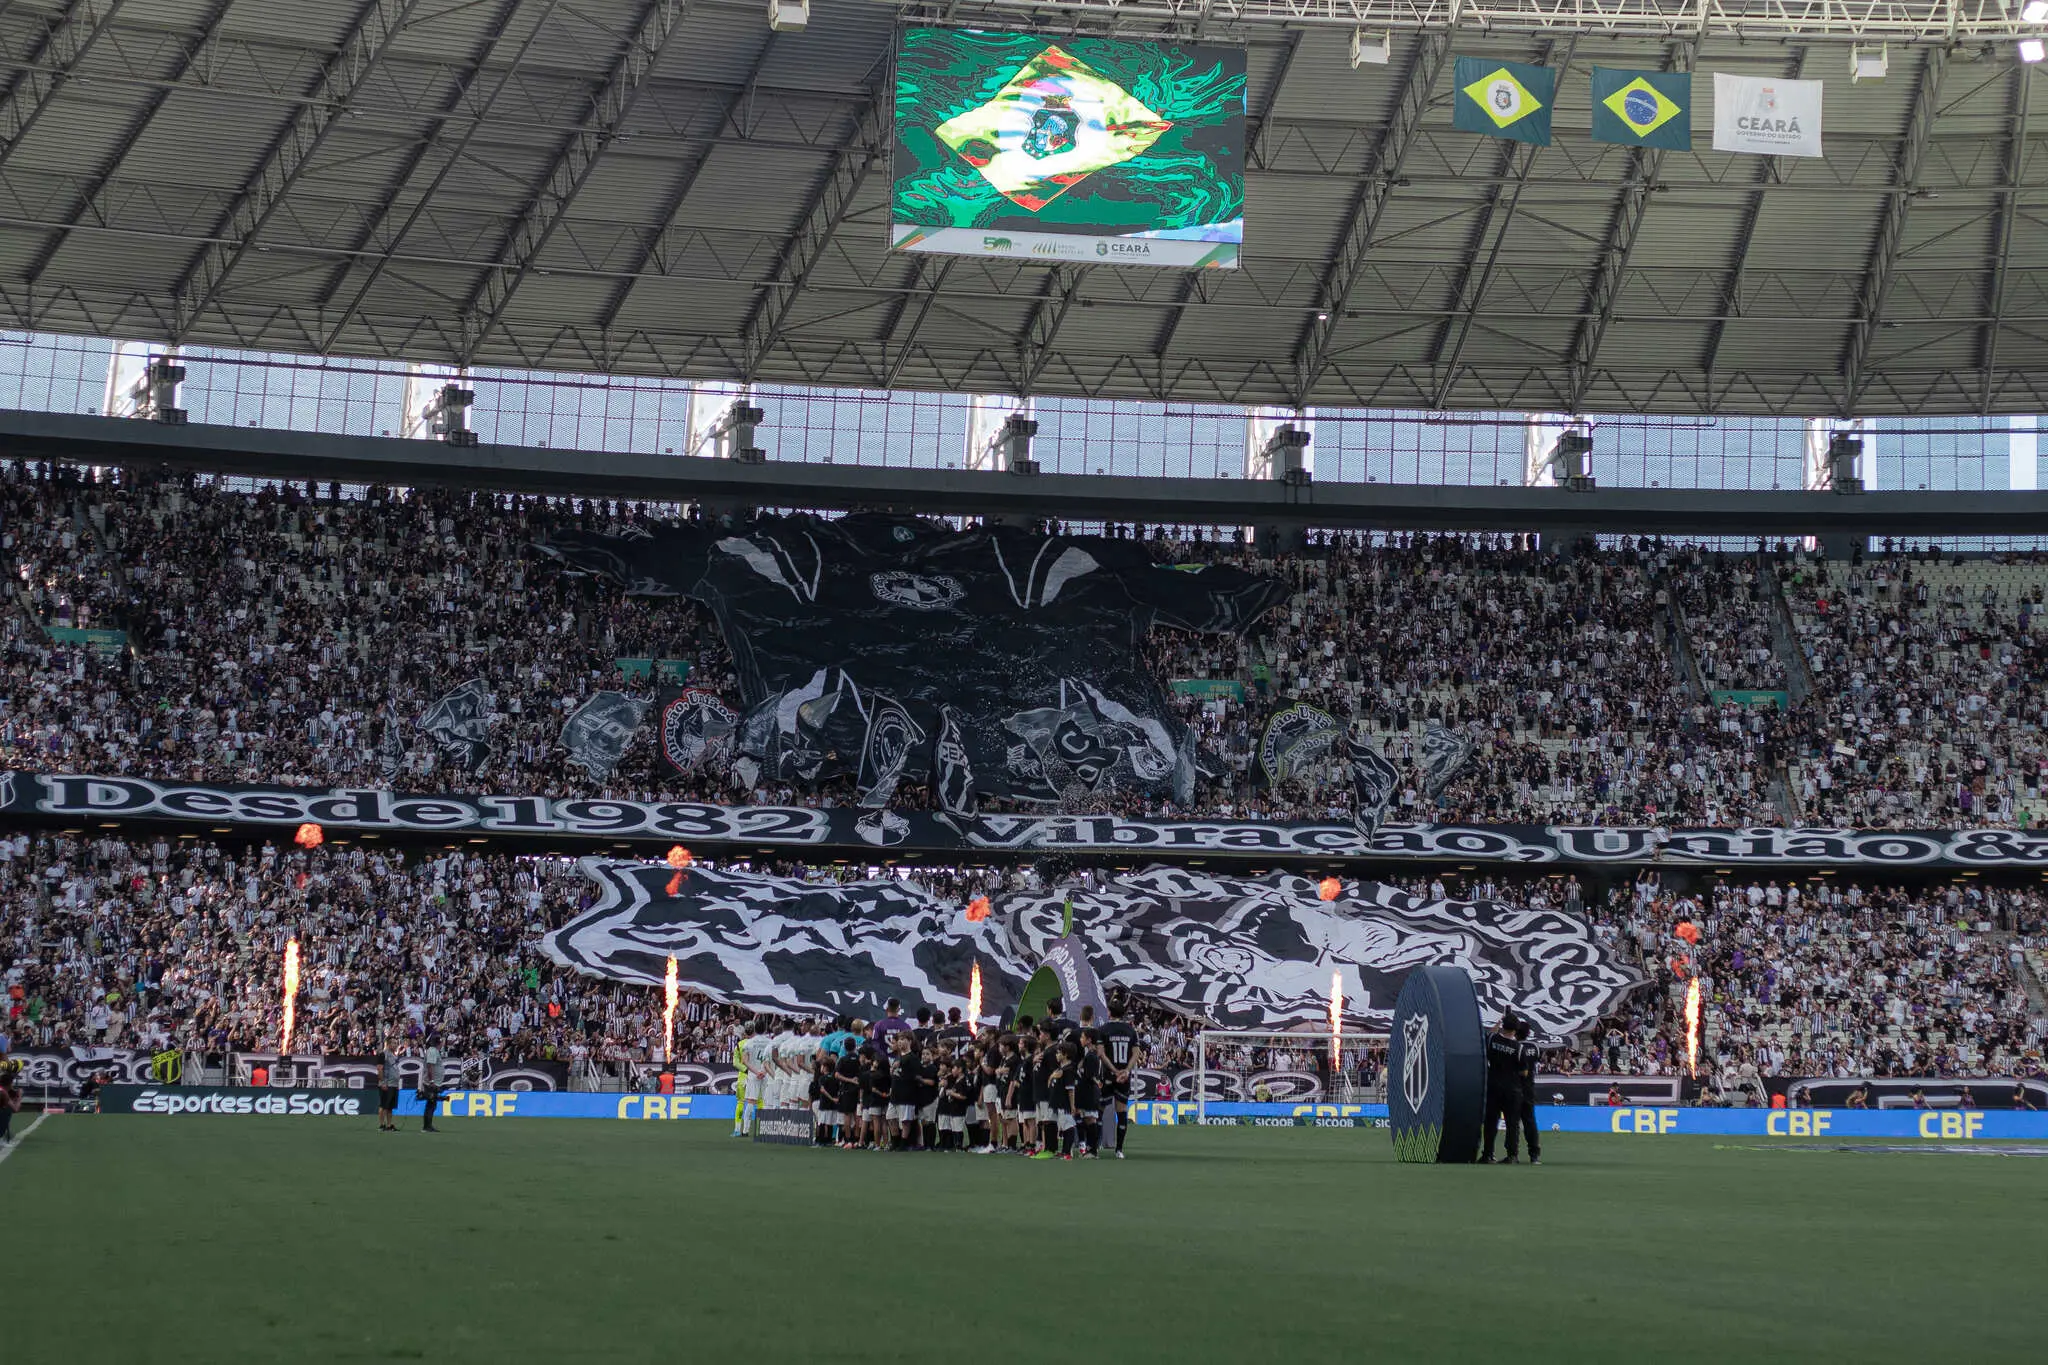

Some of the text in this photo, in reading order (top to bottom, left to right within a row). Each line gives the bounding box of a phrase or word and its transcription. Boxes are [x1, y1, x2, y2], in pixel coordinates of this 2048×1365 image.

[1737, 116, 1801, 133] CEARÁ
[1111, 243, 1151, 254] CEARÁ
[40, 774, 476, 828] Desde
[484, 796, 822, 842] 1982
[952, 813, 1554, 864] Vibração,
[1549, 826, 1940, 864] União
[1112, 1041, 1129, 1064] 10
[132, 1090, 360, 1115] Esportes da Sorte
[442, 1092, 518, 1117] CBF
[617, 1095, 692, 1120] CBF
[1255, 1117, 1294, 1127] SICOOB
[1315, 1118, 1354, 1128] SICOOB
[1375, 1119, 1390, 1128] SIC
[1611, 1108, 1678, 1134] CBF
[1766, 1110, 1833, 1137] CBF
[1919, 1111, 1985, 1139] CBF
